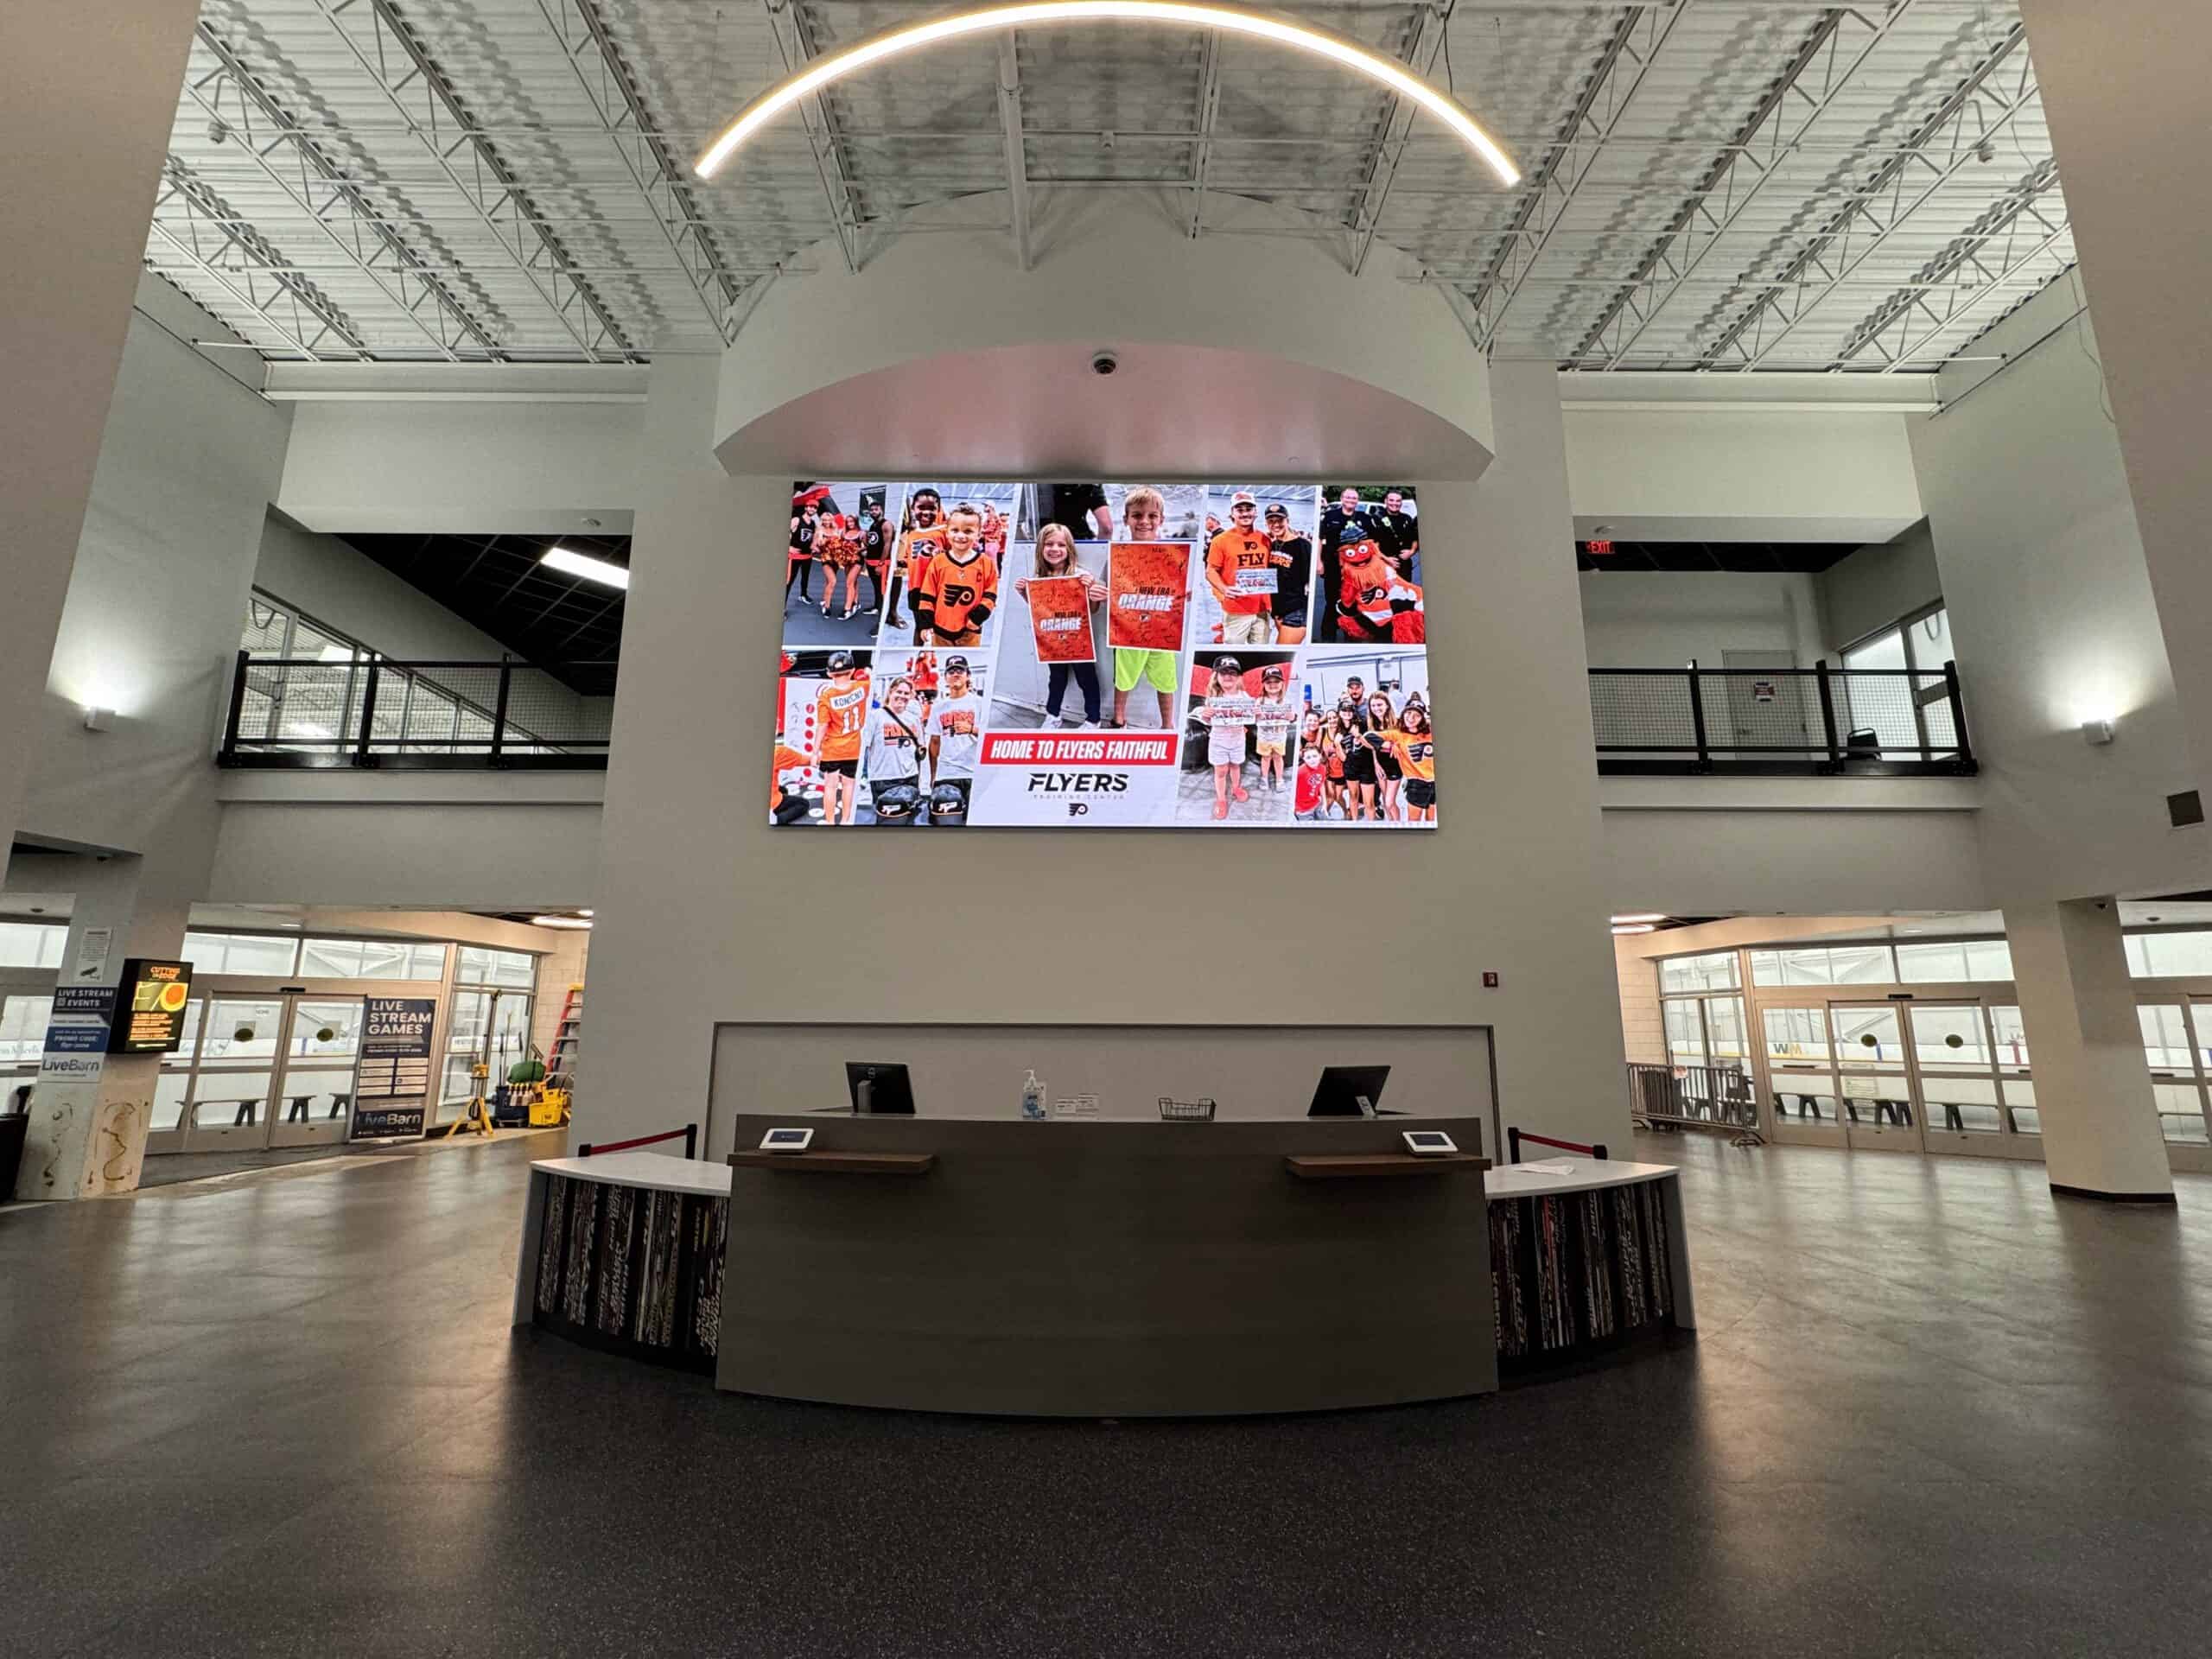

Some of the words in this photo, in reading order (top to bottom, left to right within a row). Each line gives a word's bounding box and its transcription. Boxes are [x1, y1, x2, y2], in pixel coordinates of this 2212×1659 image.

[1591, 540, 1611, 553] EXIT
[1237, 552, 1265, 567] FLY
[842, 705, 860, 734] 11
[990, 740, 1035, 760] HOME
[1036, 740, 1054, 760] TO
[1055, 740, 1106, 760] FLYERS
[1106, 741, 1168, 760] FAITHFUL
[1027, 773, 1129, 792] FLYERS
[58, 988, 76, 997] LIVE
[372, 1000, 404, 1011] LIVE
[370, 1012, 431, 1023] STREAM
[368, 1023, 423, 1035] GAMES
[41, 1058, 99, 1071] LiveBarn
